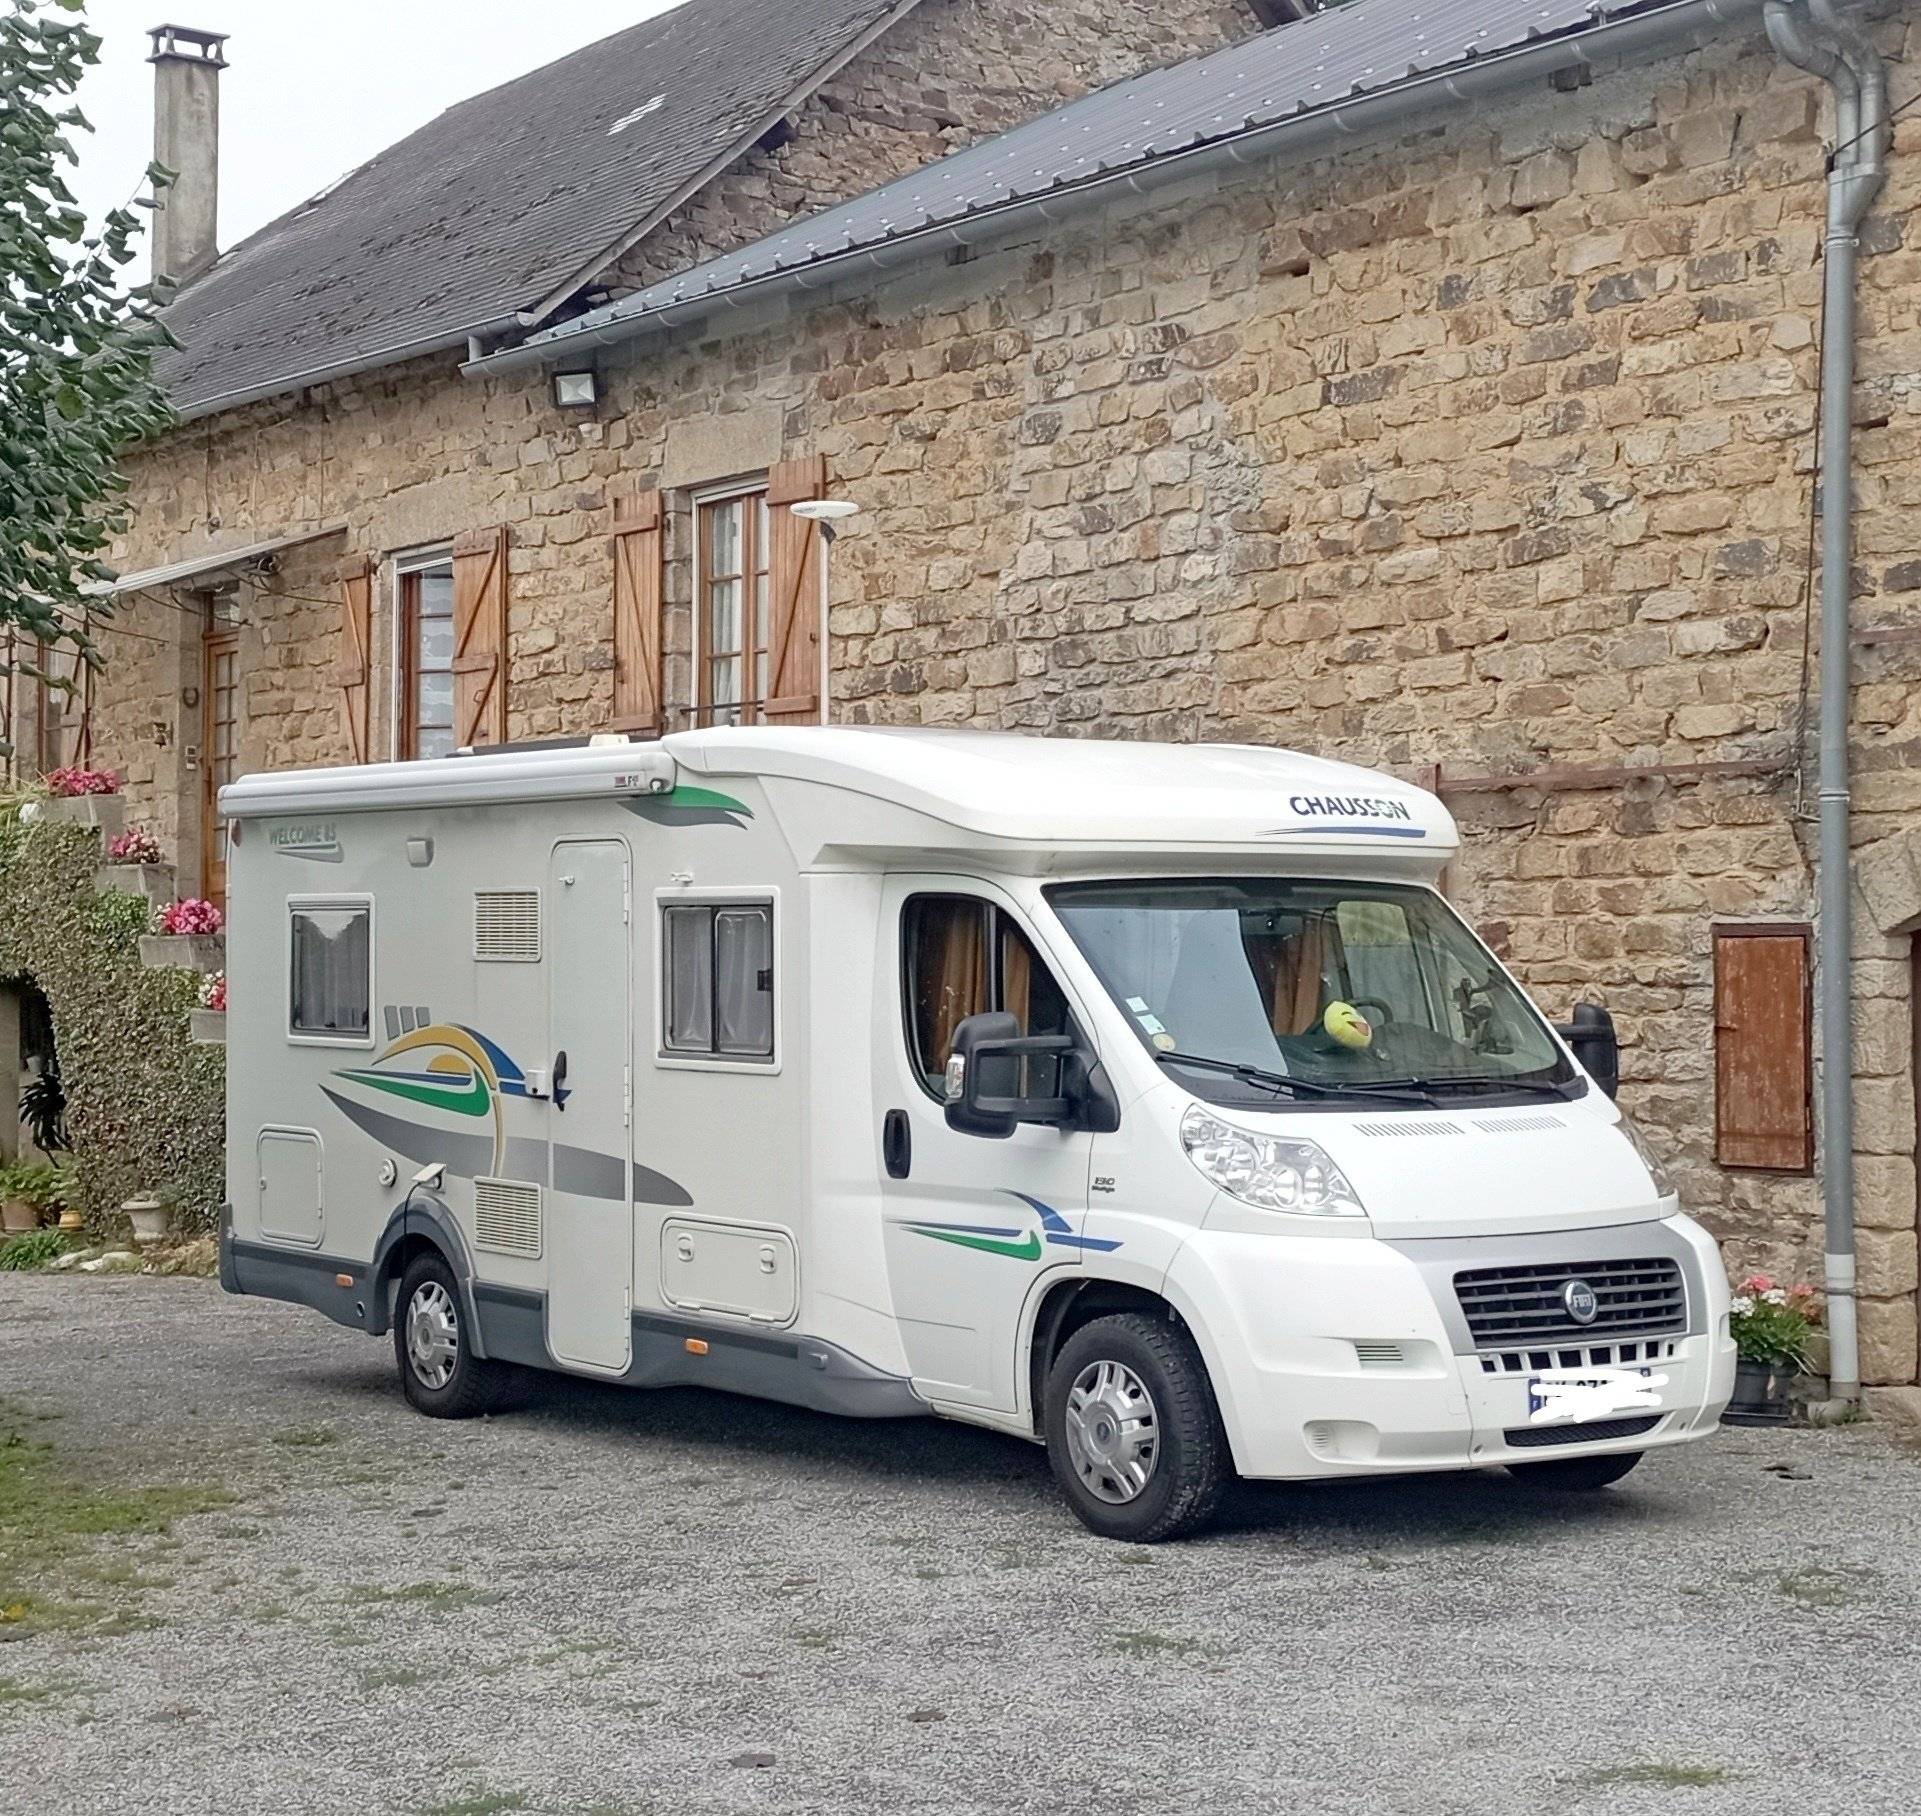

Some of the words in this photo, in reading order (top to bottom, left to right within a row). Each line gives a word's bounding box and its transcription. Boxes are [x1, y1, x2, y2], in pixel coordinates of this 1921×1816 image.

[1289, 796, 1411, 820] CHAUSSON
[268, 825, 322, 846] WELCOME
[1572, 1294, 1592, 1308] FIAT
